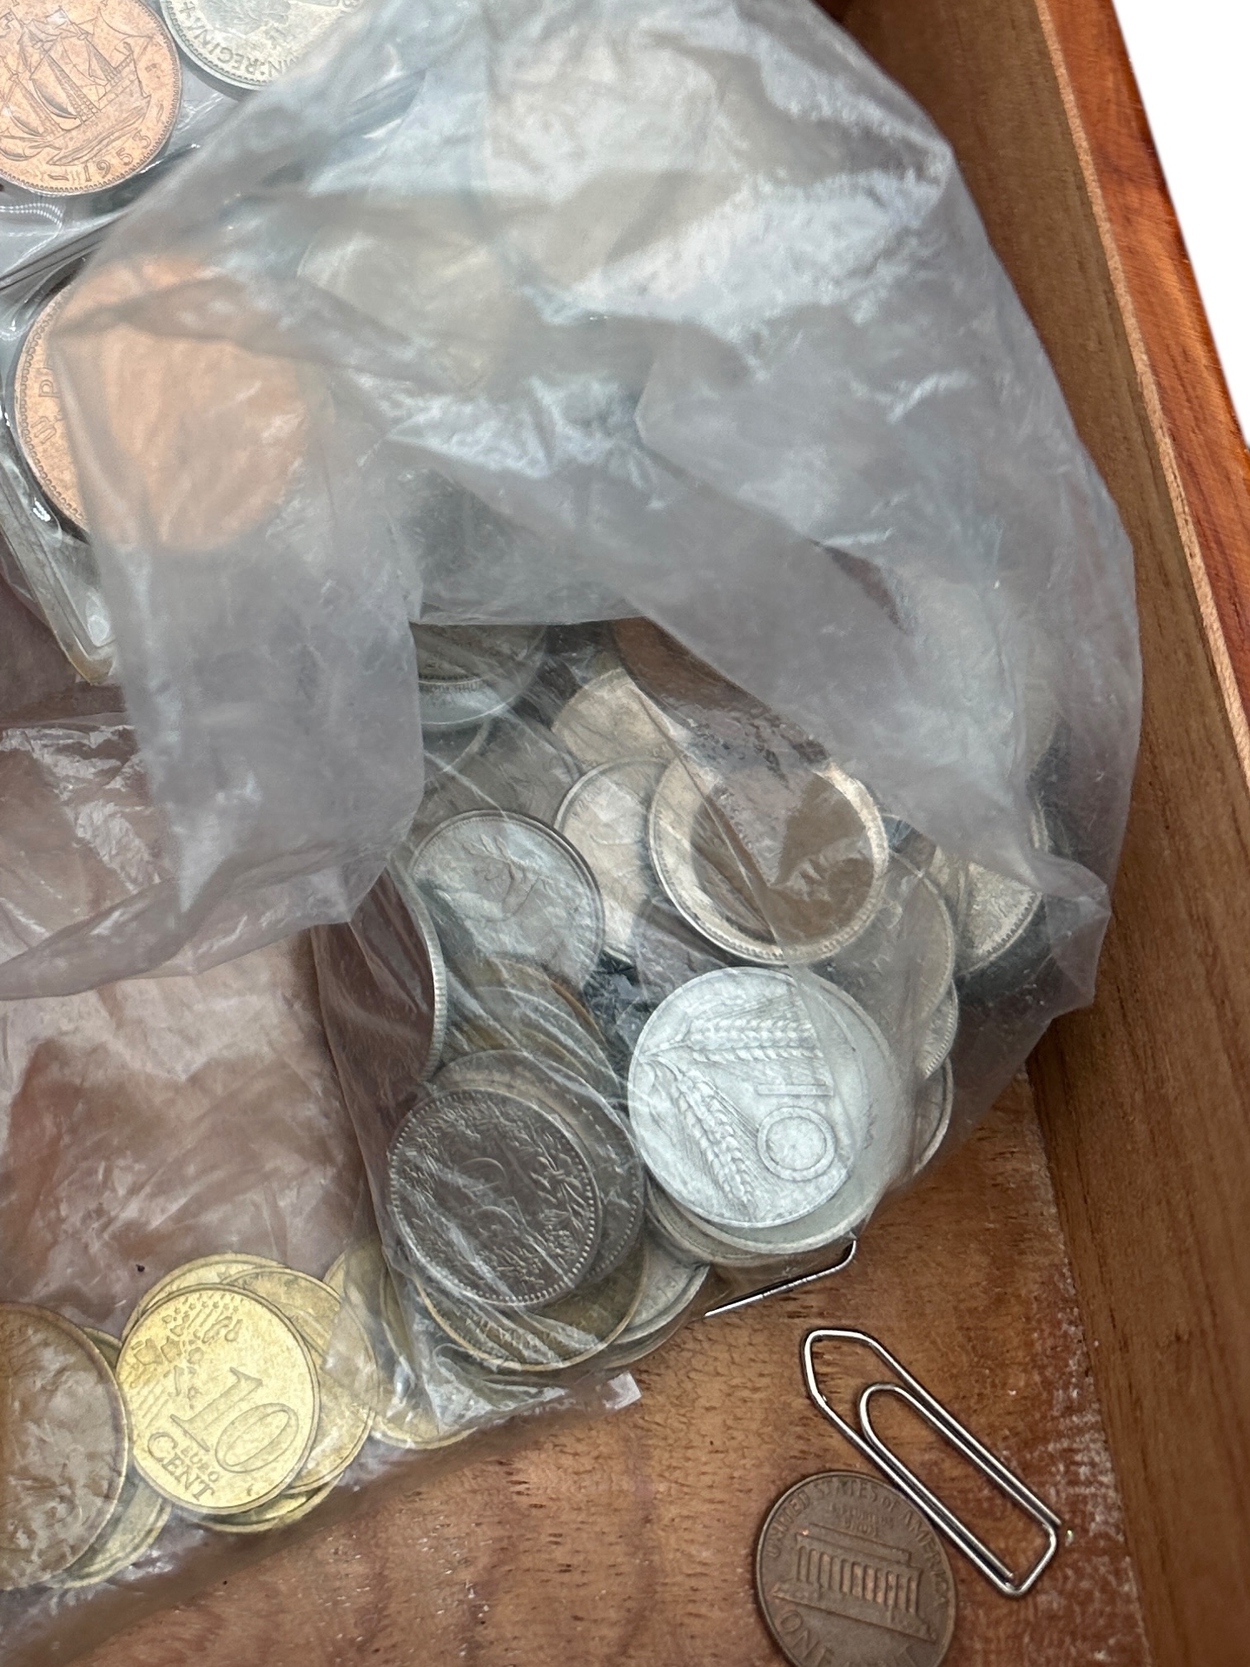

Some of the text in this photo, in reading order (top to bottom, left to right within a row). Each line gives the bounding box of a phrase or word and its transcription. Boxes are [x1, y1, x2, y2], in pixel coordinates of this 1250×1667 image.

[83, 130, 151, 182] 1953
[170, 1368, 299, 1473] 10
[148, 1432, 218, 1503] CENT
[180, 1442, 220, 1483] EURO
[766, 1491, 812, 1559] UNITED
[814, 1478, 879, 1503] STATES
